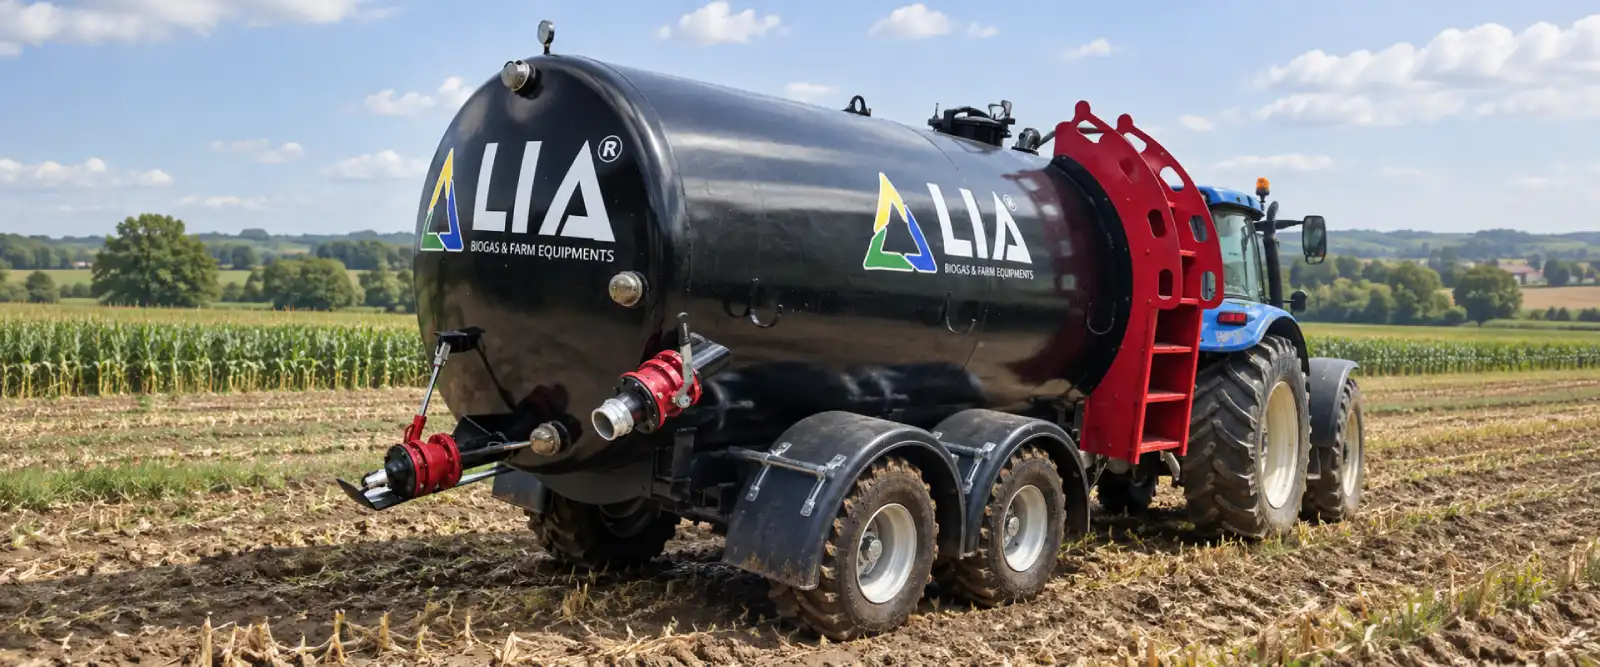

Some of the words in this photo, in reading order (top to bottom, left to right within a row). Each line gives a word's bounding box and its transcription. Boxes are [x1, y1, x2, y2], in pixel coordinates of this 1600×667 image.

[472, 139, 616, 242] LIA
[926, 182, 1033, 264] LIA
[470, 240, 500, 254] BIOGAS
[500, 242, 508, 254] &
[509, 243, 536, 256] FARM
[538, 244, 615, 262] EQUIPMENTS
[944, 262, 971, 275] BIOGAS
[971, 265, 977, 276] &
[977, 266, 996, 277] FARM
[996, 267, 1034, 280] EQUIPMENTS
